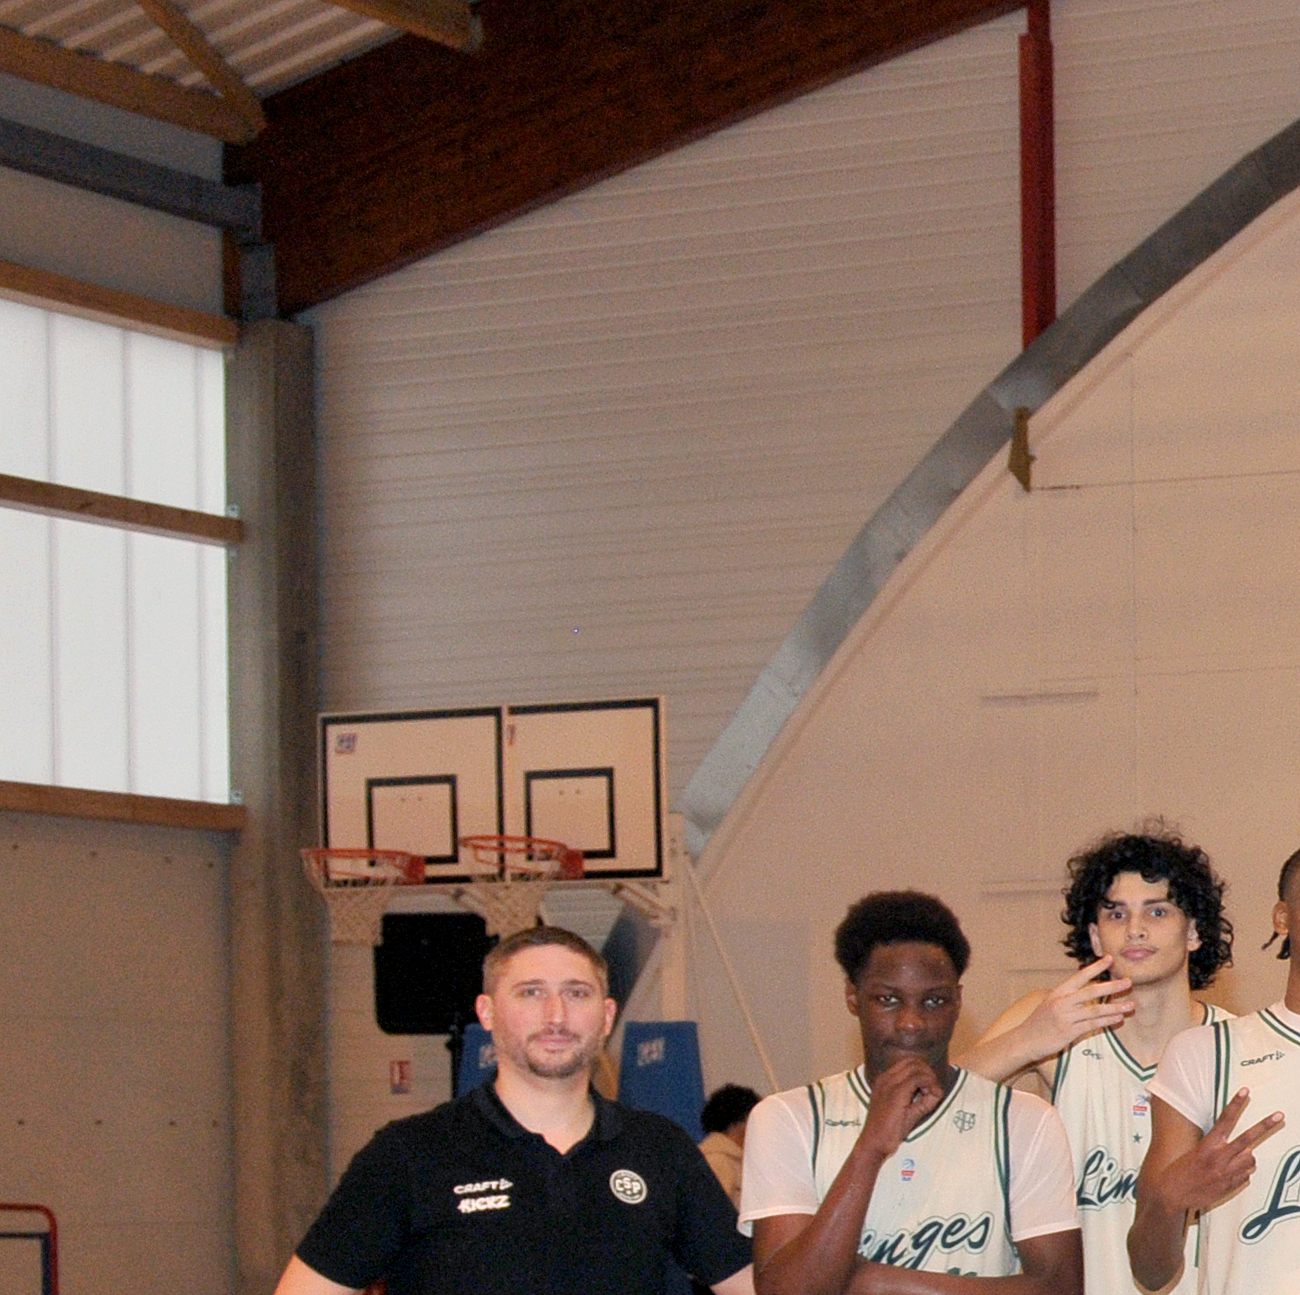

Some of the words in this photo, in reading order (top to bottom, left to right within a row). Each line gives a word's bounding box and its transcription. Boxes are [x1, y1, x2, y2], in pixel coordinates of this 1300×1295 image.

[1240, 1052, 1275, 1067] CRAFT
[453, 1181, 499, 1194] CRAFT
[615, 1177, 641, 1194] CSP
